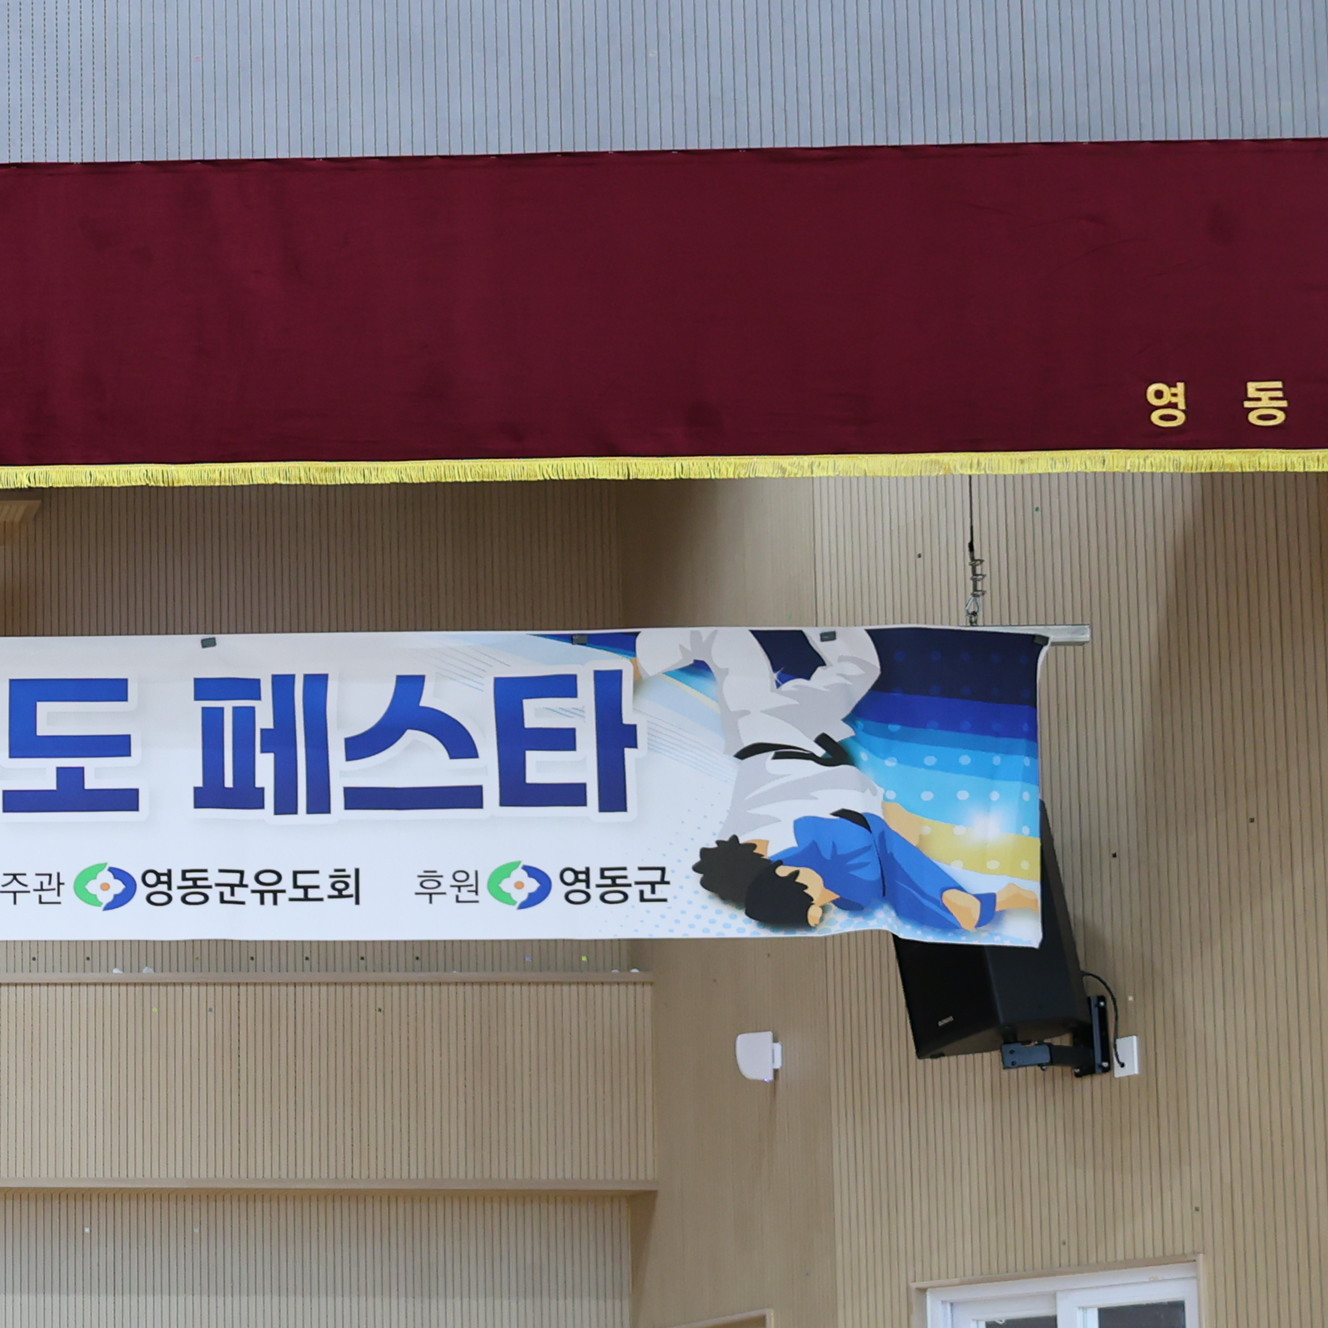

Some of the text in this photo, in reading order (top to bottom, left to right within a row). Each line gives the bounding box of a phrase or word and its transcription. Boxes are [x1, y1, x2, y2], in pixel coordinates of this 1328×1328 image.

[193, 669, 640, 816] 페스타
[0, 867, 362, 908] 주관 영동군유도회
[414, 865, 672, 907] 후원 영동군
